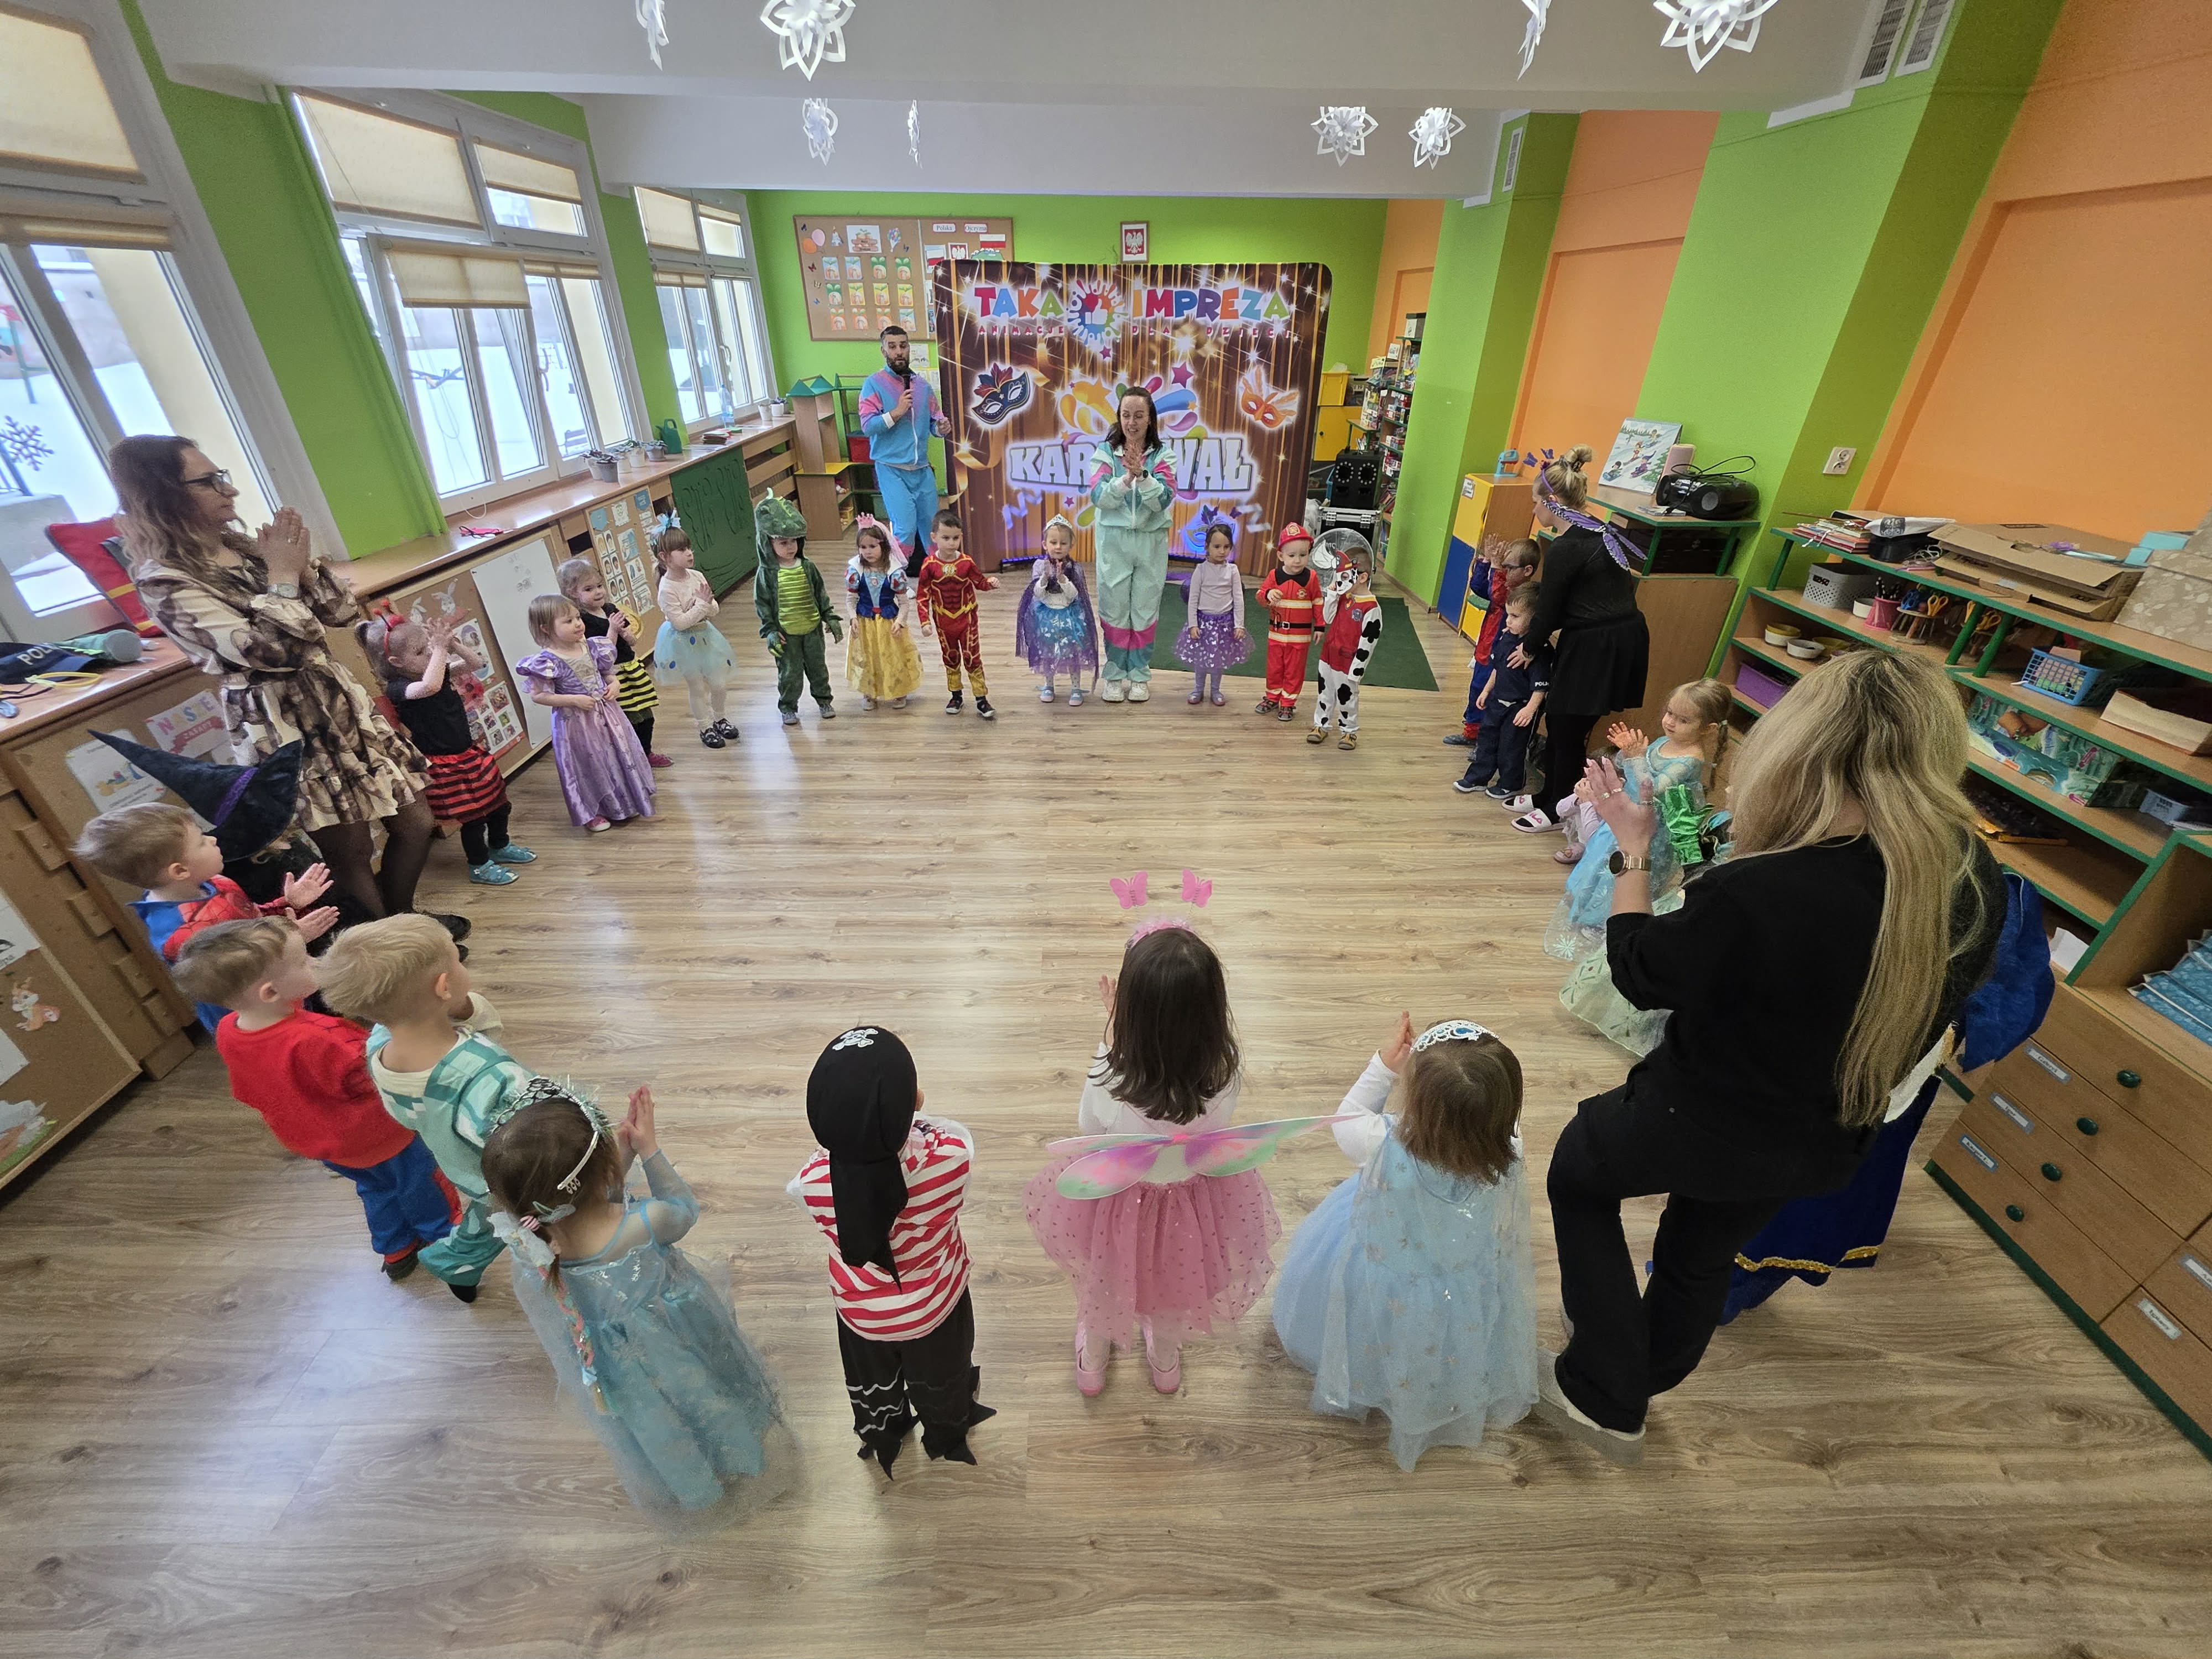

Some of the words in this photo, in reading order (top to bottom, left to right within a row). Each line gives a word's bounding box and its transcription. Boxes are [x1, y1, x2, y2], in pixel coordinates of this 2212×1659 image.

[974, 286, 1065, 318] TAKA
[1133, 286, 1290, 322] IMPREZA
[978, 325, 1064, 335] ANIMACJE
[1132, 325, 1172, 335] DLA
[1206, 326, 1290, 338] DZIECI
[1010, 438, 1252, 491] KARWAŁ
